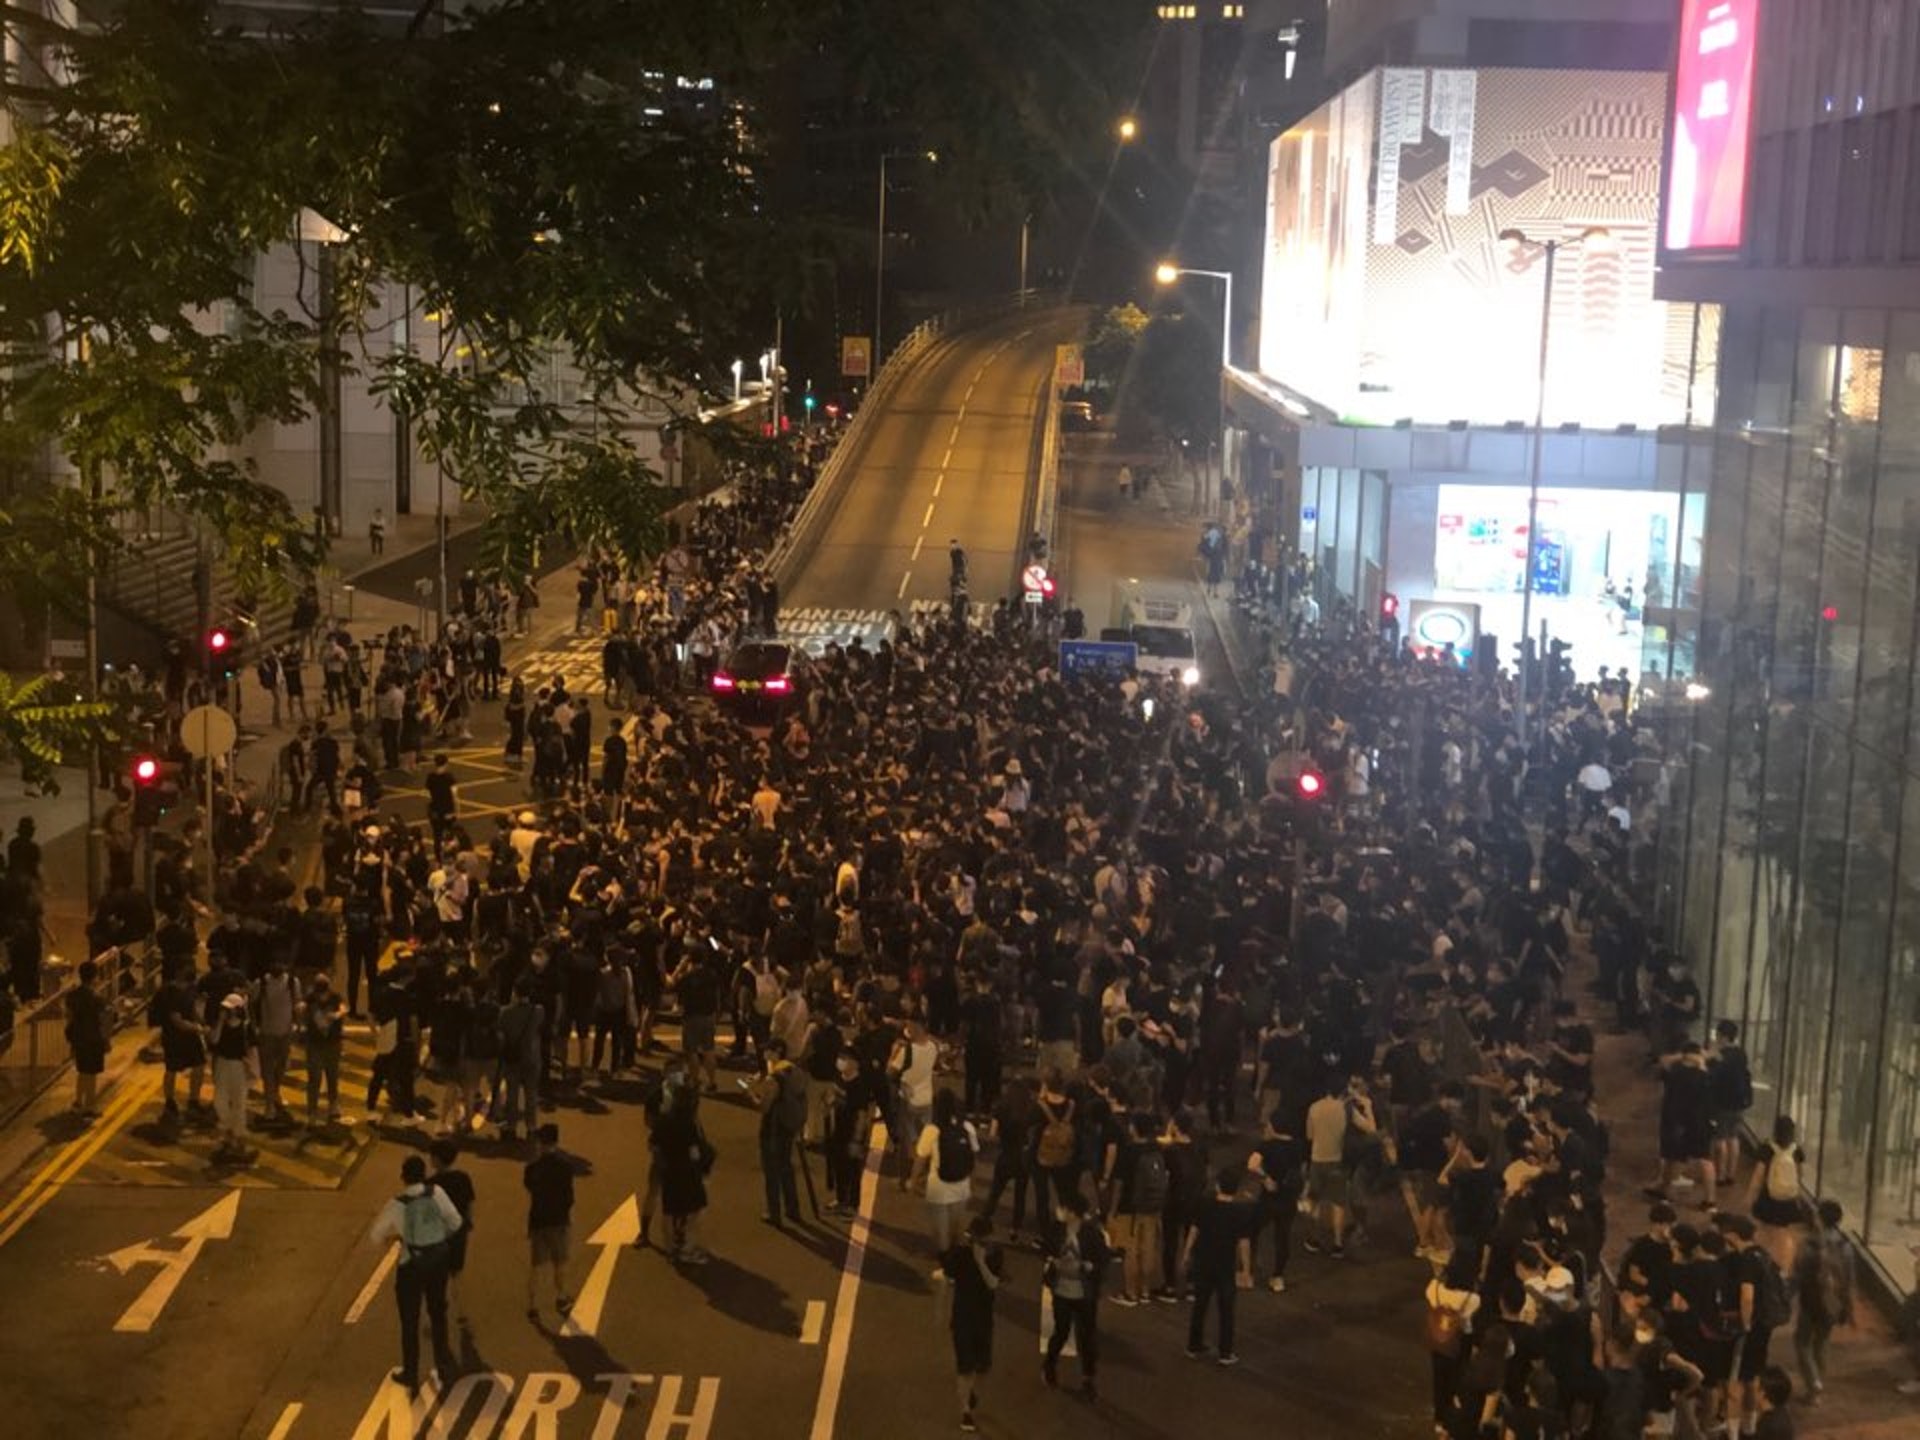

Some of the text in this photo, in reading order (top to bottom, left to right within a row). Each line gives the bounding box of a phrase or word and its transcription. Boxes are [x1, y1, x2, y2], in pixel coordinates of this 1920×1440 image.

[1381, 75, 1401, 183] ASIAWORLD
[1406, 73, 1421, 125] HALL
[778, 611, 886, 623] WAN CHAI
[351, 1367, 721, 1440] NORTH
